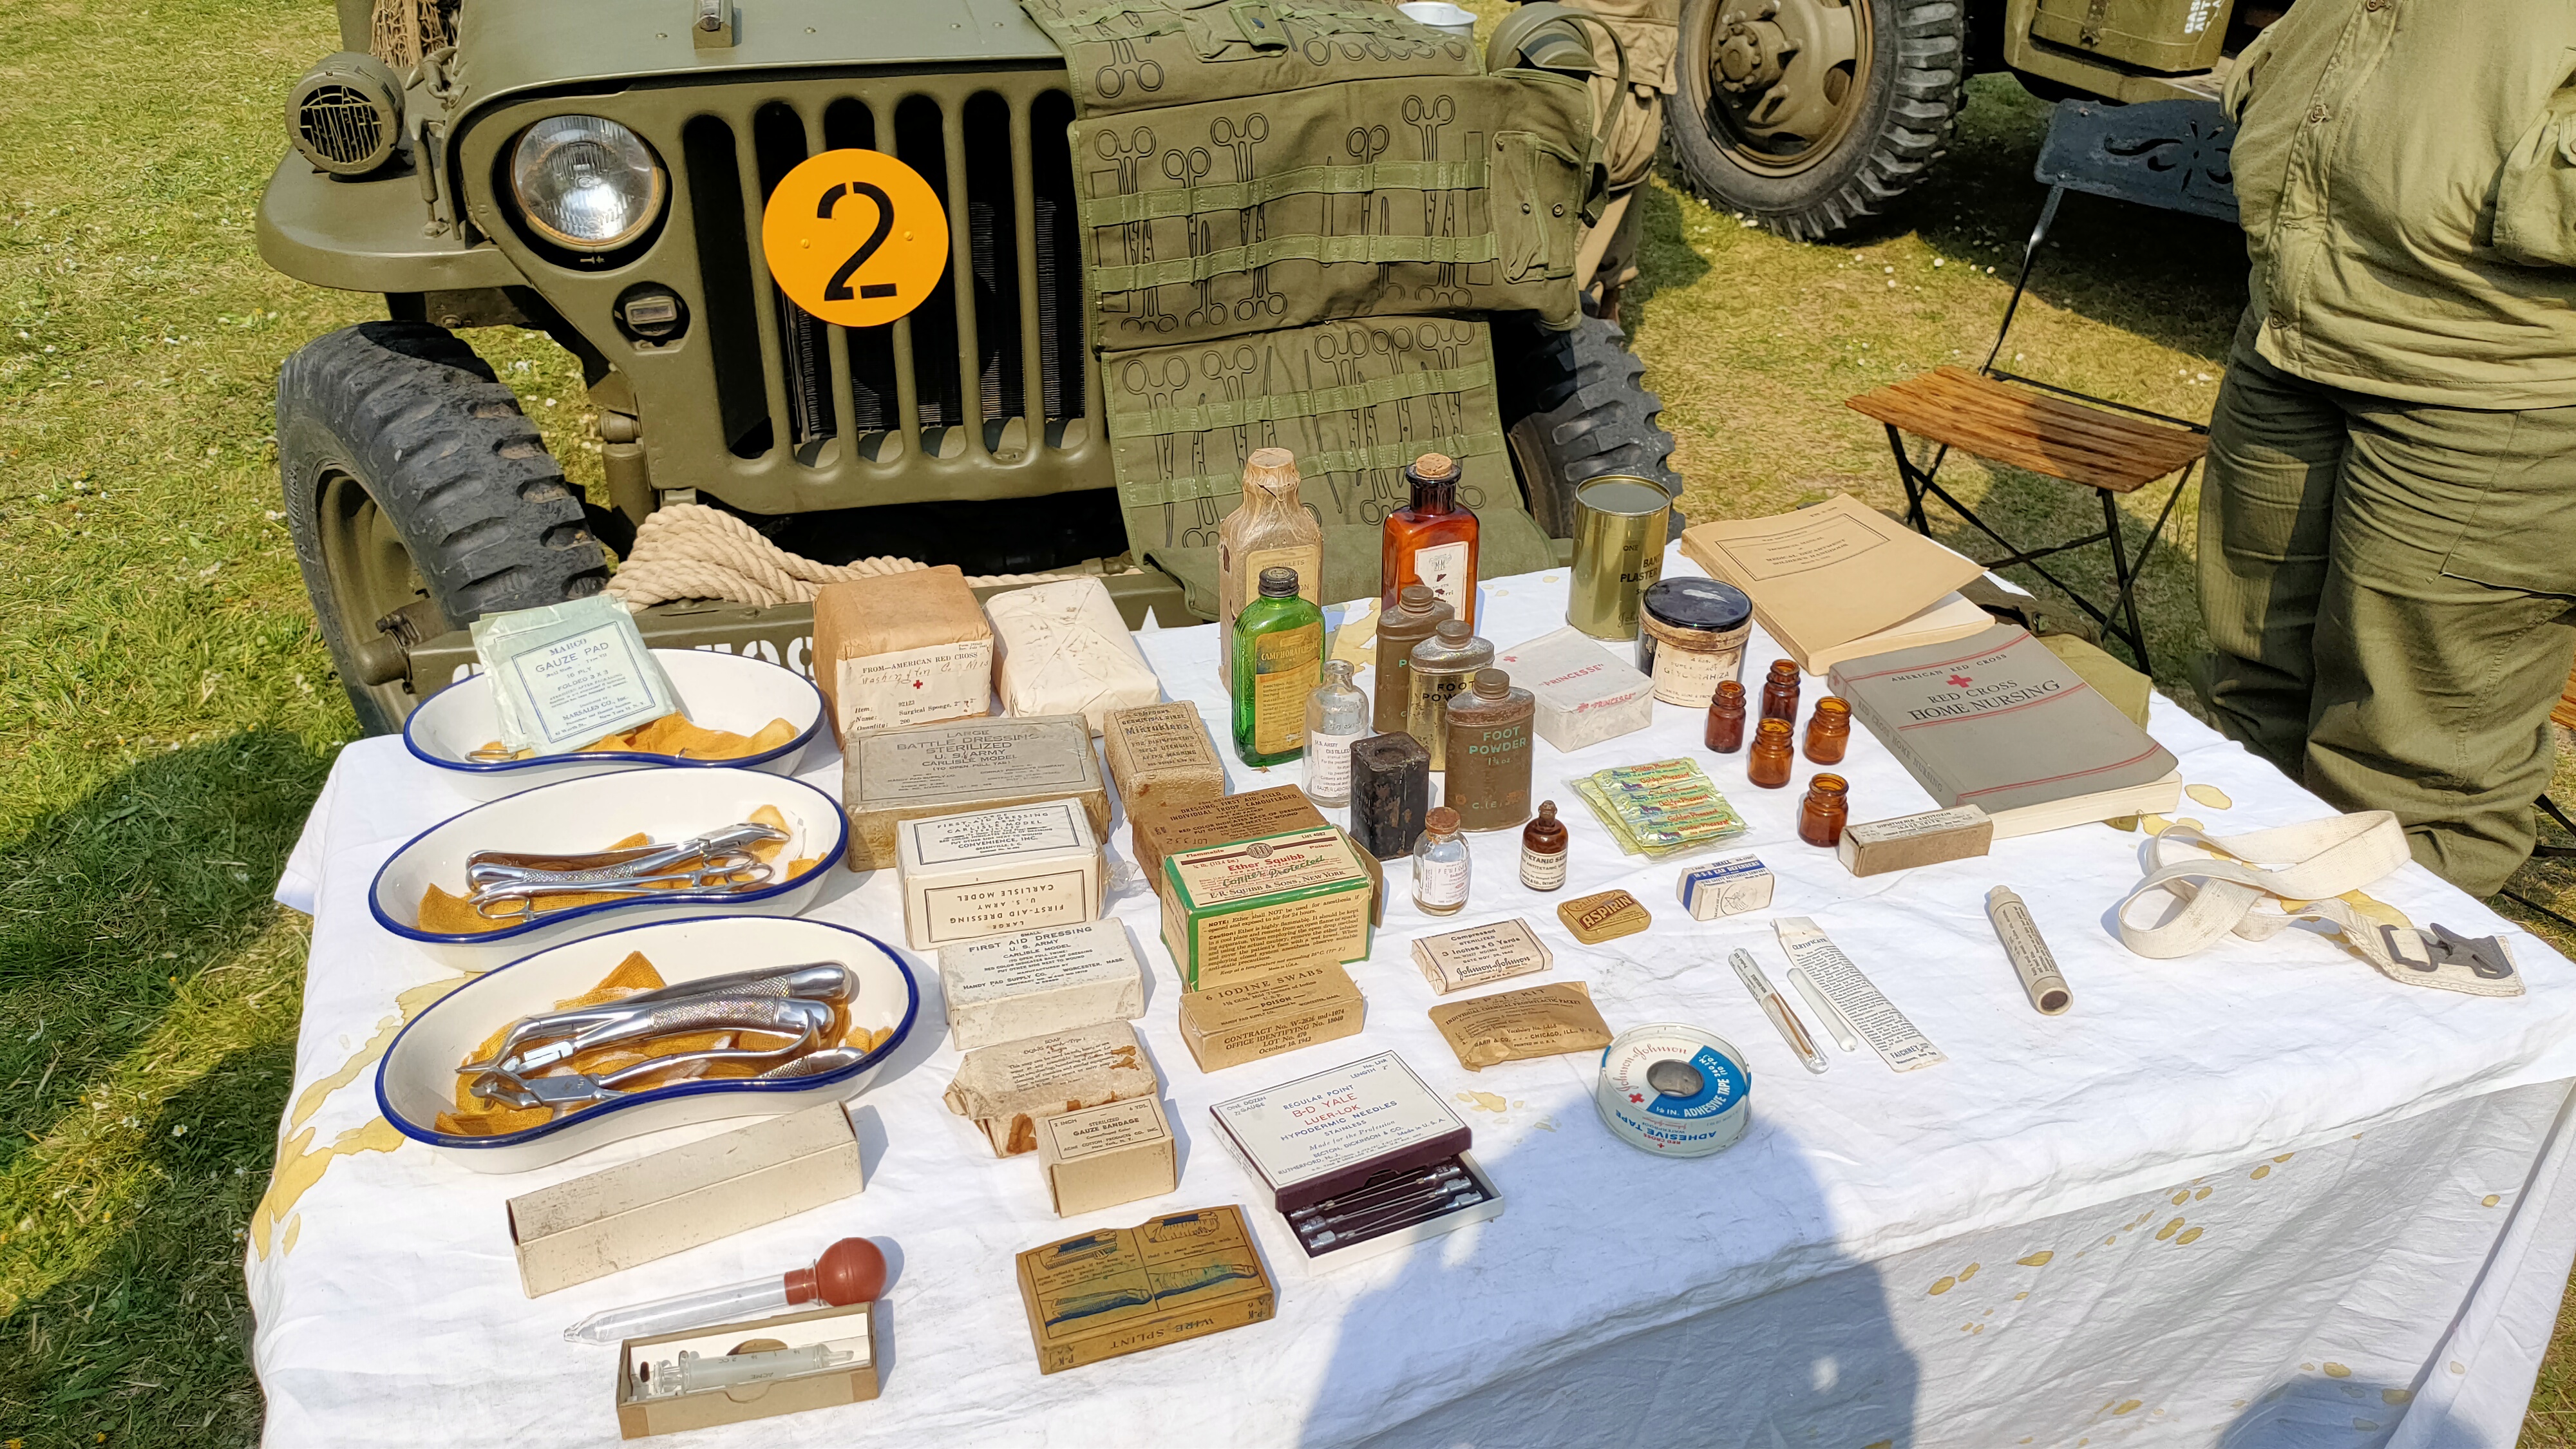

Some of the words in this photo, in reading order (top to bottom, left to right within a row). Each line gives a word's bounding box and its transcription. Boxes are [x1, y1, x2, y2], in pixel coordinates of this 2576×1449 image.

[817, 182, 897, 301] 2
[1620, 567, 1659, 583] PLASTER
[549, 638, 587, 656] MARCO
[535, 652, 578, 672] GAUZE
[584, 642, 609, 656] PAD
[1891, 670, 1943, 683] AMERICAN
[1949, 663, 1969, 672] RED
[1976, 653, 2008, 667] CROSS
[558, 677, 588, 691] FOLDED
[1437, 681, 1475, 692] FOOT
[1927, 690, 1964, 705] RED
[1965, 679, 2019, 698] CROSS
[1907, 701, 1971, 722] HOME
[1973, 679, 2061, 712] NURSING
[899, 707, 925, 717] Surgical
[928, 703, 952, 712] Sponge,
[947, 730, 990, 739] LARGE
[1482, 725, 1521, 741] FOOT
[896, 739, 958, 750] BATTLE
[926, 742, 1012, 754] STERILIZED
[1468, 737, 1527, 755] POWDER
[969, 749, 1006, 757] ARMY
[1871, 714, 1890, 738] CROSS
[1891, 737, 1911, 758] HOME
[1913, 757, 1943, 793] NURSING
[922, 757, 976, 767] CARLISLE
[1170, 810, 1213, 821] INDIVIDUAL
[1245, 795, 1300, 808] CAMOUFLAGED,
[1180, 803, 1218, 813] DRESSING,
[937, 818, 992, 829] FIRST-AID
[998, 812, 1049, 821] DRESSING
[958, 838, 1018, 848] CONVENIENCE,
[1186, 849, 1224, 858] Flammable
[1227, 861, 1260, 871] Ether
[1264, 853, 1305, 866] Squibb
[957, 891, 994, 902] MODEL
[1000, 884, 1054, 897] CARLISLE
[978, 902, 1006, 911] ARMY
[1009, 904, 1064, 917] FIRST-AID
[1208, 919, 1229, 927] NOTE:
[1323, 896, 1352, 906] anesthesia
[1582, 896, 1633, 927] ASPIRIN
[950, 913, 1003, 923] DRESSING
[992, 921, 1024, 929] LARGE
[969, 942, 1001, 952] FIRST
[1036, 926, 1093, 941] DRESSING
[1034, 939, 1059, 947] ARMY
[1450, 929, 1496, 941] Compressed
[1459, 935, 1495, 945] STERILIZED
[1003, 948, 1040, 959] CARLISLE
[1045, 943, 1072, 951] MODEL
[1452, 945, 1480, 954] Inches
[1496, 937, 1520, 945] Yards
[1792, 938, 1828, 950] CERTIFICATE
[963, 981, 986, 990] HANDY
[1007, 974, 1031, 983] SUPPLY
[1062, 961, 1103, 972] WORCESTER,
[1218, 980, 1271, 998] IODINE
[1277, 968, 1324, 984] SWABS
[1260, 996, 1292, 1008] POISON
[1224, 1027, 1273, 1044] CONTRACT
[1226, 1039, 1255, 1050] OFFICE
[1256, 1025, 1310, 1042] IDENTIFYING
[1530, 1030, 1562, 1039] CHICAGO,
[1259, 1043, 1287, 1054] October
[1298, 1036, 1311, 1045] 1942
[1263, 1039, 1280, 1047] LOT
[1633, 1043, 1687, 1060] Johnson
[1890, 1045, 1920, 1059] FAICHNEY
[1350, 1068, 1376, 1079] LENGTH
[1613, 1057, 1640, 1092] Johnson
[1226, 1104, 1242, 1112] ONE
[1242, 1096, 1267, 1106] DOZEN
[1283, 1095, 1323, 1110] REGULAR
[1326, 1084, 1354, 1097] POINT
[1684, 1095, 1727, 1117] ADHESIVE
[1717, 1078, 1730, 1096] TAPE
[1292, 1104, 1316, 1118] B-D
[1321, 1093, 1358, 1109] YALE
[1060, 1118, 1078, 1126] INCH
[1088, 1117, 1120, 1128] STERILIZED
[1280, 1117, 1347, 1141] HYPODERMIC
[1352, 1101, 1398, 1119] NEEDLES
[1303, 1104, 1361, 1126] LUER-LOK
[1615, 1109, 1643, 1132] TAPE
[1073, 1126, 1100, 1136] GAUZE
[1103, 1117, 1139, 1130] BANDAGE
[1323, 1120, 1367, 1137] STAINLESS
[1359, 1119, 1396, 1137] Profession
[1647, 1128, 1717, 1141] ADHESIVE
[1081, 1139, 1103, 1148] COTTON
[1105, 1133, 1132, 1142] PRODUCTS
[1313, 1147, 1342, 1159] BECTON,
[1344, 1135, 1382, 1148] DICKINSON
[1278, 1157, 1323, 1175] RUTHERFORD,
[1175, 1318, 1214, 1332] WIRE
[1110, 1329, 1165, 1350] SPLINT
